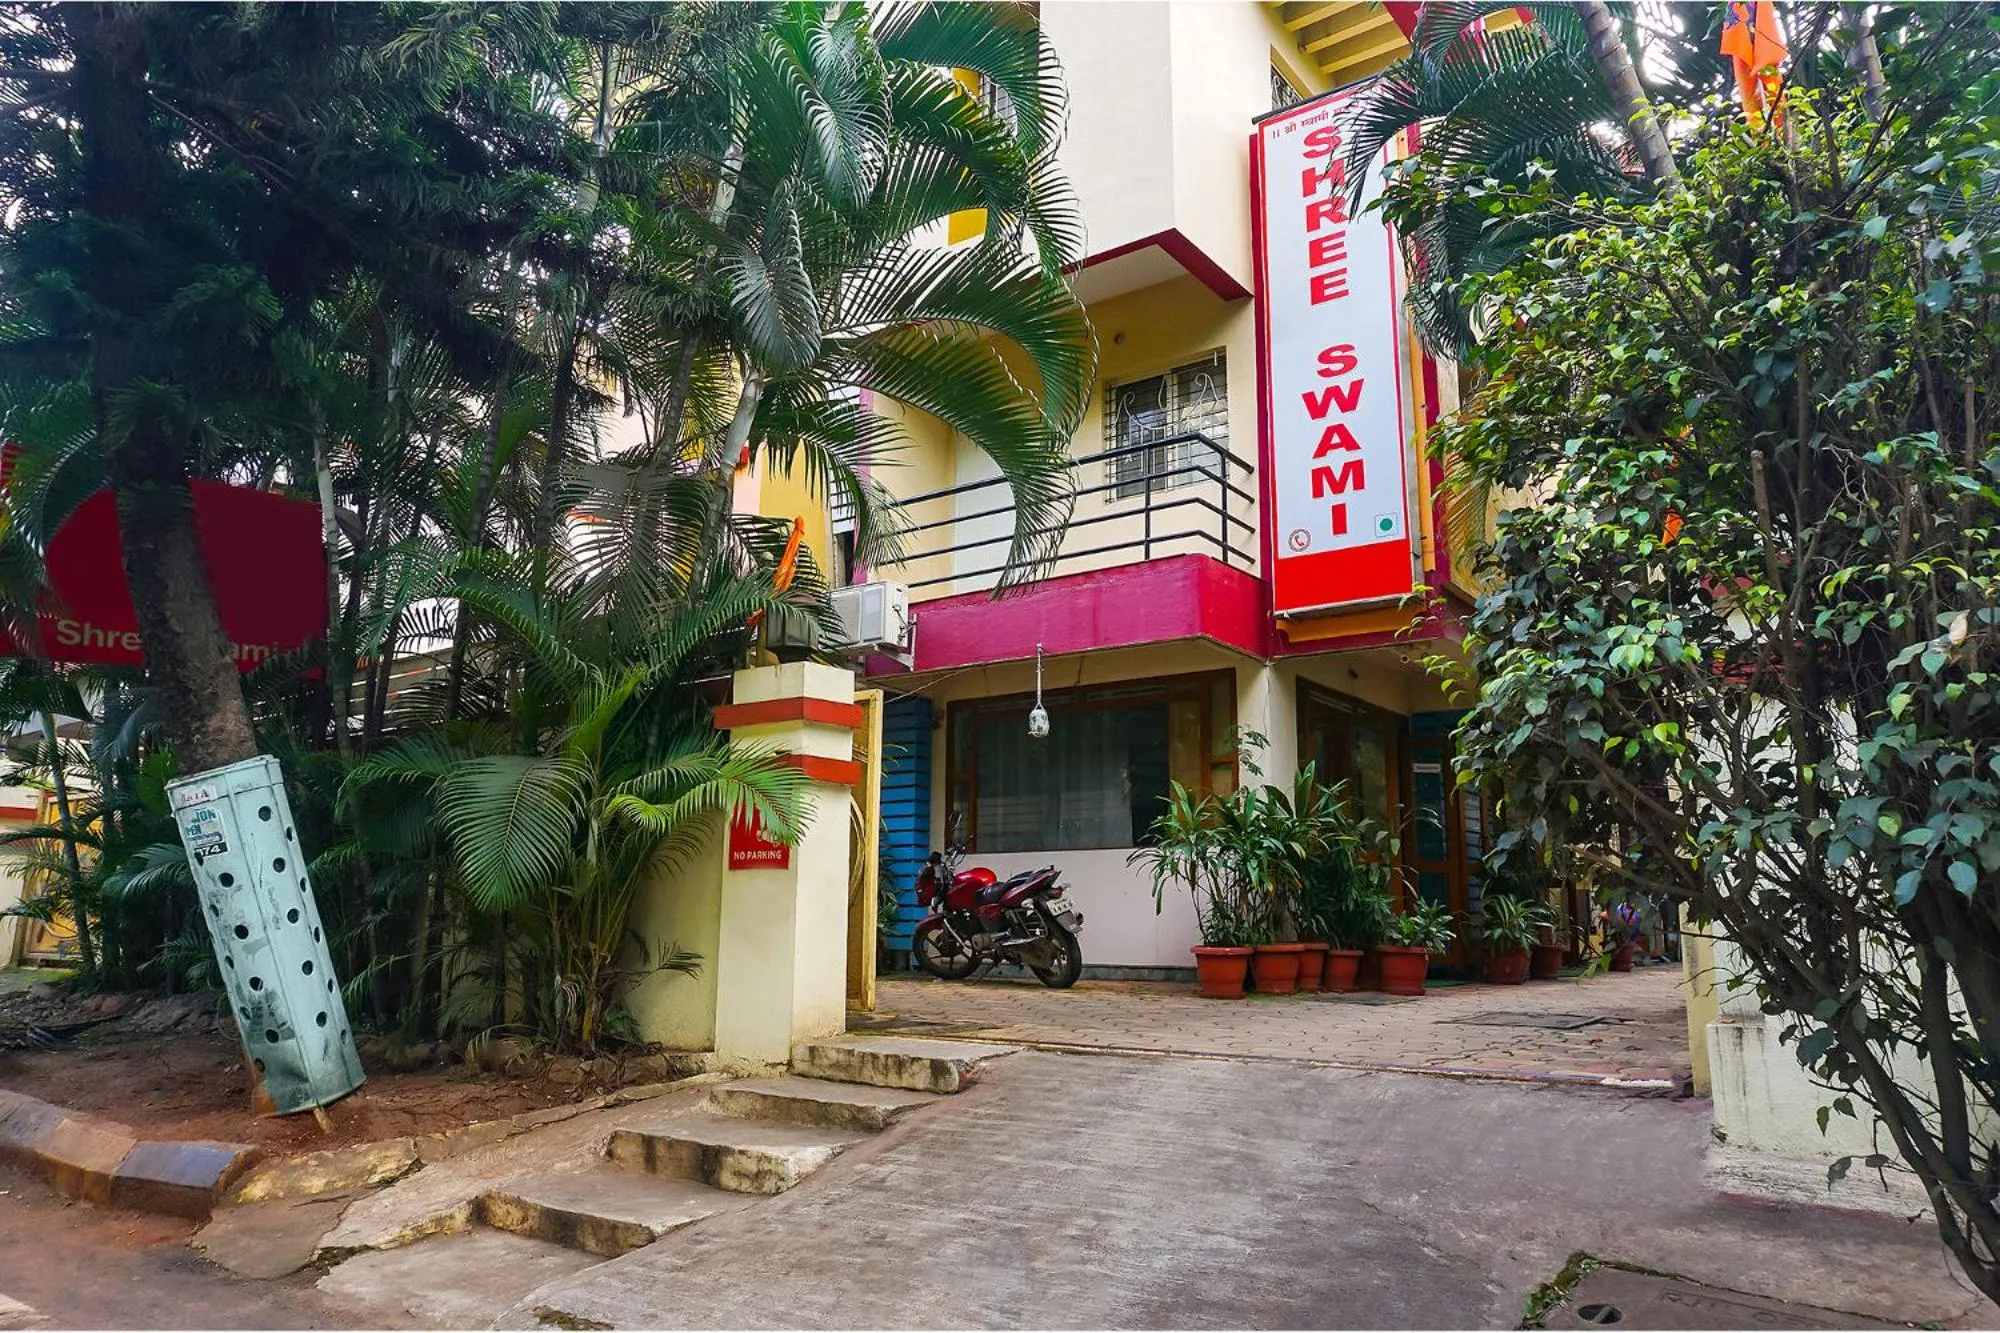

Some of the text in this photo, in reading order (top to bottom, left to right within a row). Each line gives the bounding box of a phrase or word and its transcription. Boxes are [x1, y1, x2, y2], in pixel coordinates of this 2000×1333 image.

[1301, 125, 1350, 306] SHREE
[1302, 343, 1365, 536] SWAMI
[56, 619, 143, 651] Shre
[733, 850, 783, 861] NO PARKING
